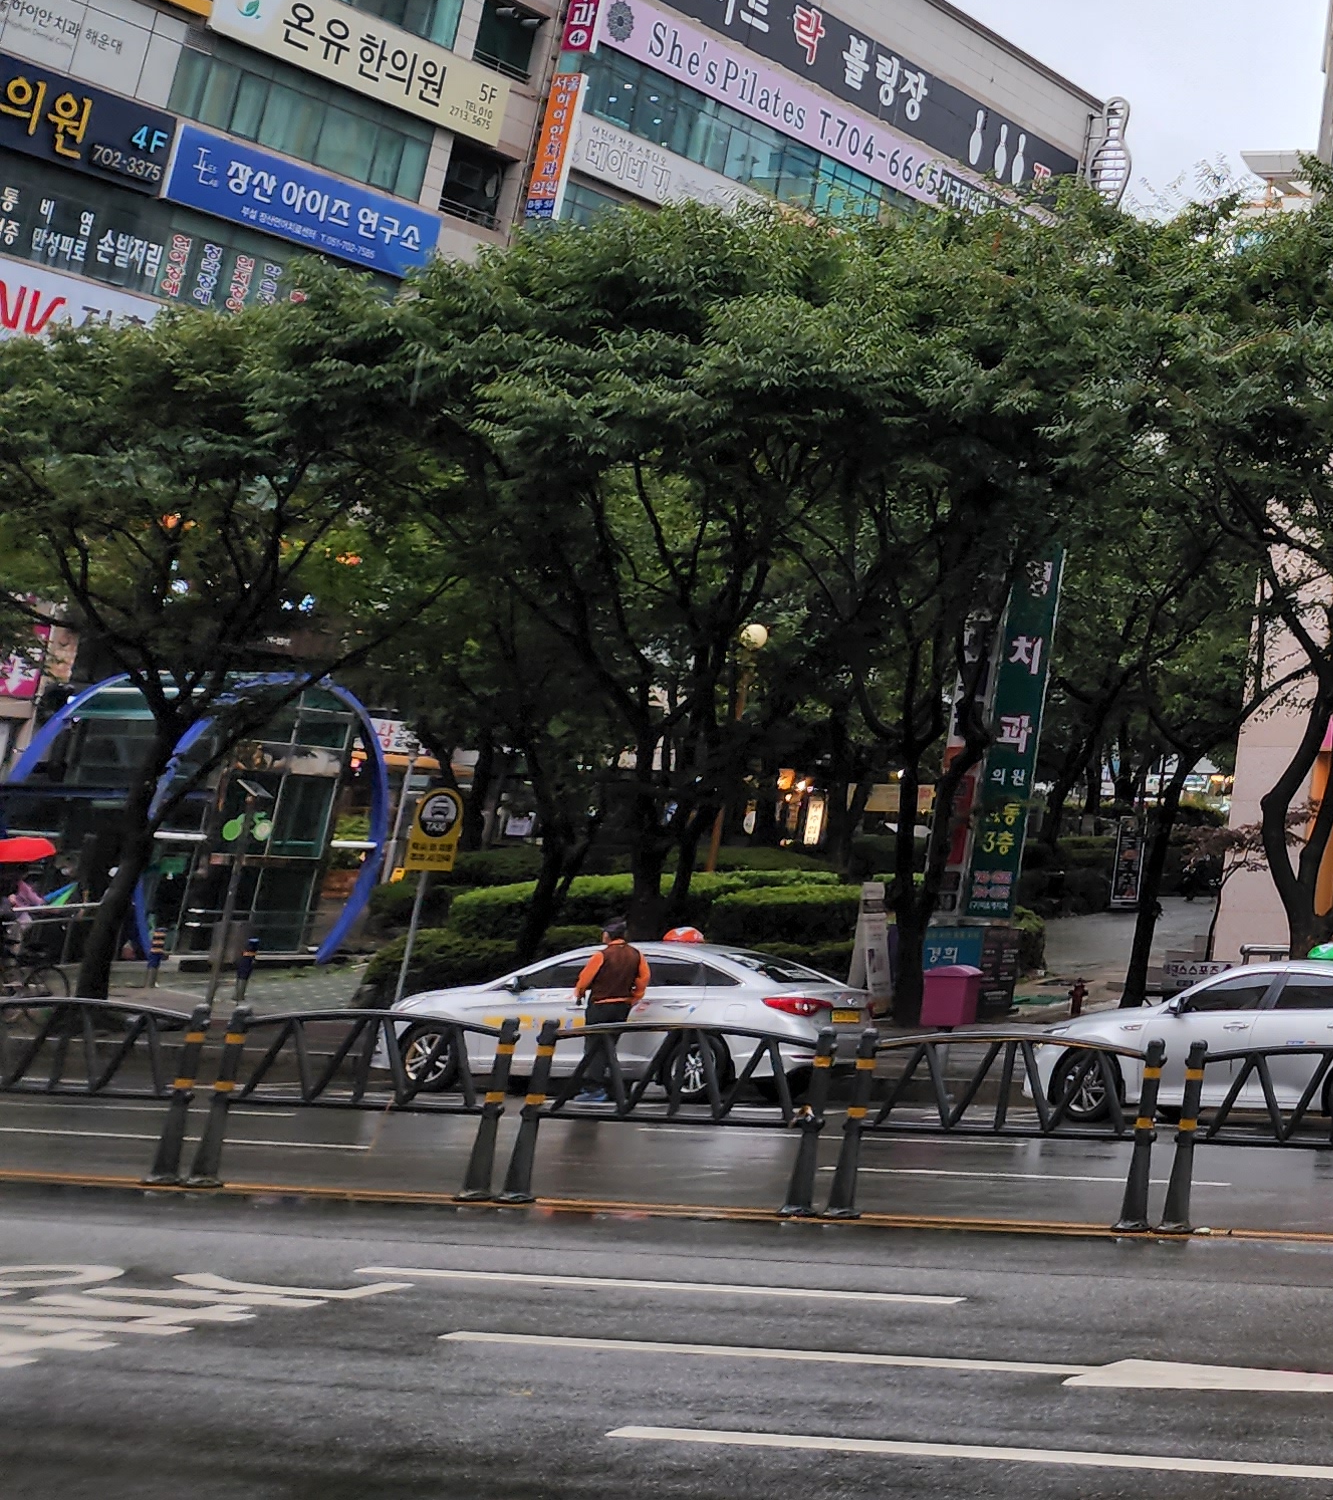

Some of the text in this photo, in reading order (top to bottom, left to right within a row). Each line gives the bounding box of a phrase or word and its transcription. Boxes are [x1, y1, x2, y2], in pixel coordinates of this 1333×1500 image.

[282, 2, 447, 109] 온유 한의원
[793, 4, 826, 65] 락
[842, 33, 929, 122] 볼링장
[465, 99, 493, 120] TEL 010
[478, 82, 498, 105] 5F
[131, 125, 169, 154] 4F
[92, 144, 163, 182] 702-3375
[585, 138, 650, 189] 베이비
[226, 159, 422, 252] 장산 아이즈 연구소
[97, 229, 163, 279] 손발저림
[990, 766, 1026, 787] 의원
[982, 831, 1015, 855] 3층
